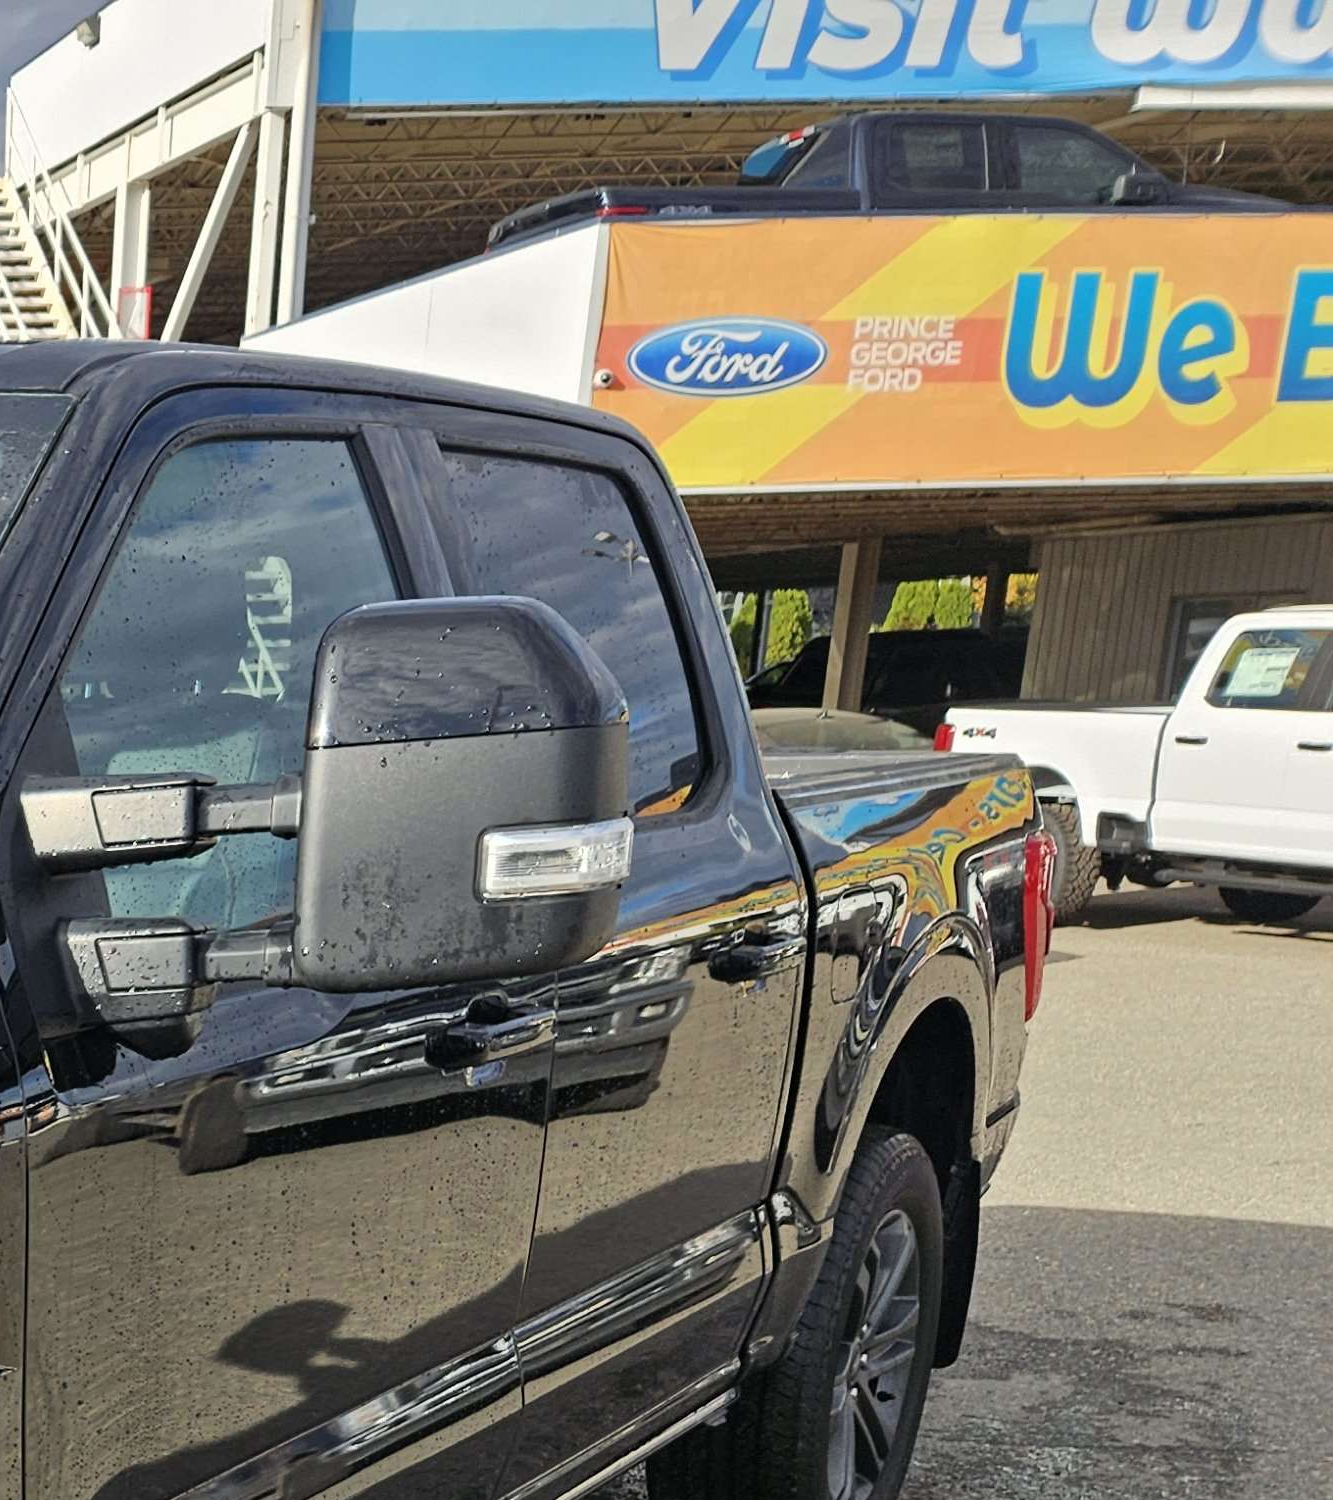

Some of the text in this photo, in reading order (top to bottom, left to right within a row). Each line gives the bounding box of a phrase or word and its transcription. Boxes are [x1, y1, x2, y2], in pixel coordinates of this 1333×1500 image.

[854, 315, 955, 339] PRINCE
[1005, 272, 1235, 408] We
[665, 329, 789, 383] Ford
[851, 341, 963, 366] GEORGE
[847, 367, 922, 392] FORD
